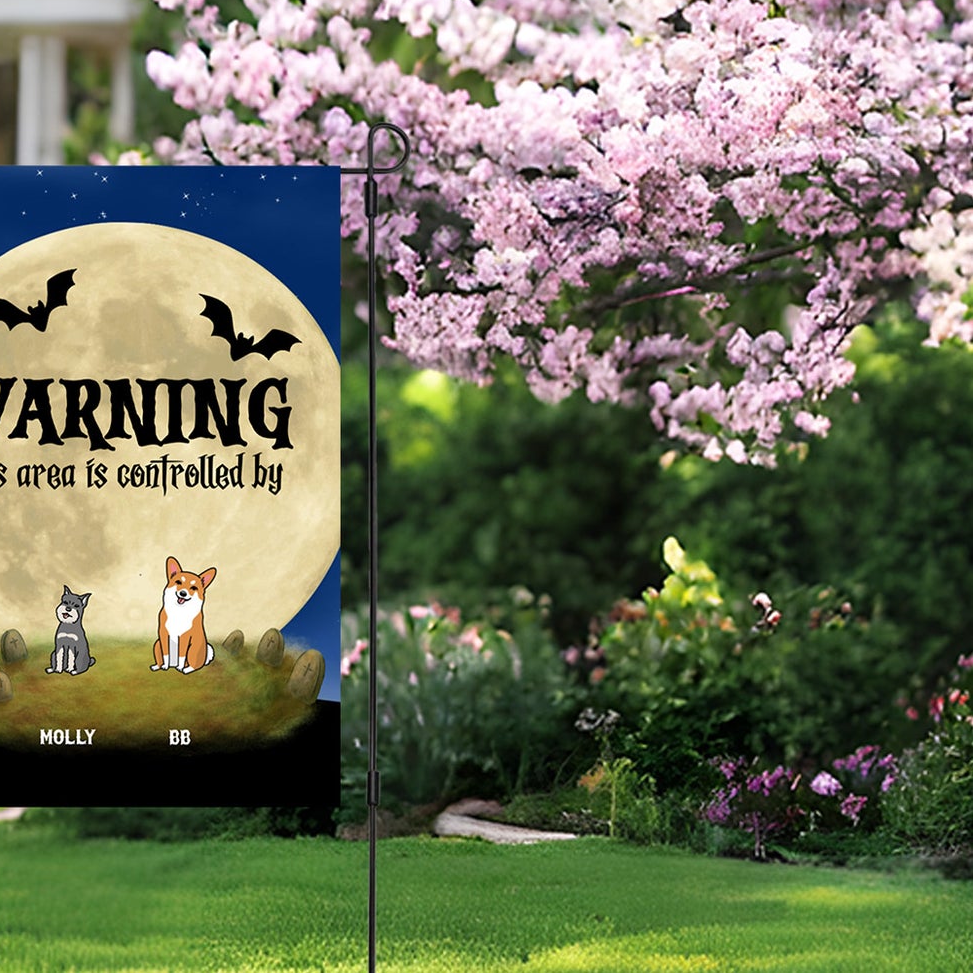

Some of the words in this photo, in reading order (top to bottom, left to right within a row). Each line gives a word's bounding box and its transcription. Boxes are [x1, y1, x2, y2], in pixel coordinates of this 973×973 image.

[16, 460, 76, 490] area
[86, 456, 108, 489] is
[116, 452, 245, 496] controlled
[251, 452, 284, 495] by
[39, 729, 96, 746] MOLLY
[168, 729, 192, 746] BB
